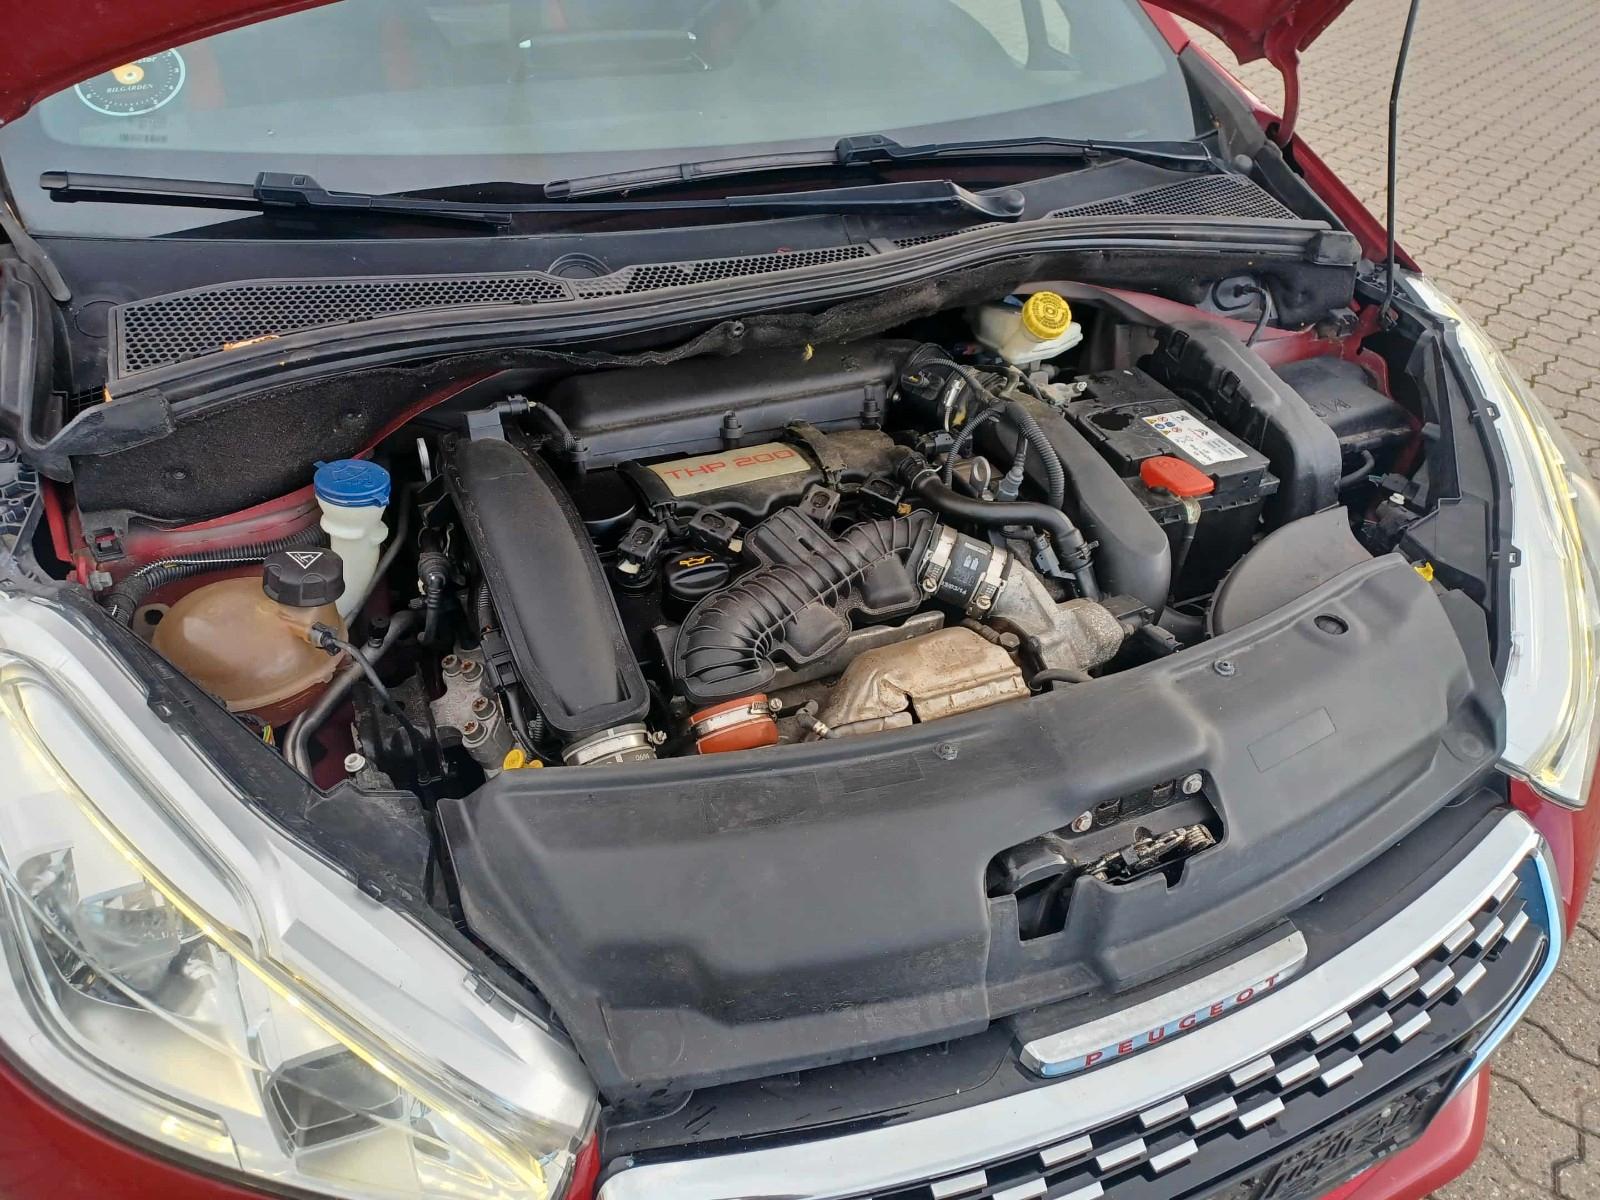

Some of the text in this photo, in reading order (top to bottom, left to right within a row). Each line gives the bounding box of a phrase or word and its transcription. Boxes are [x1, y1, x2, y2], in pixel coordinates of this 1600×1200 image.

[664, 449, 796, 481] THP 200
[1084, 972, 1280, 1069] PEUGEOT
